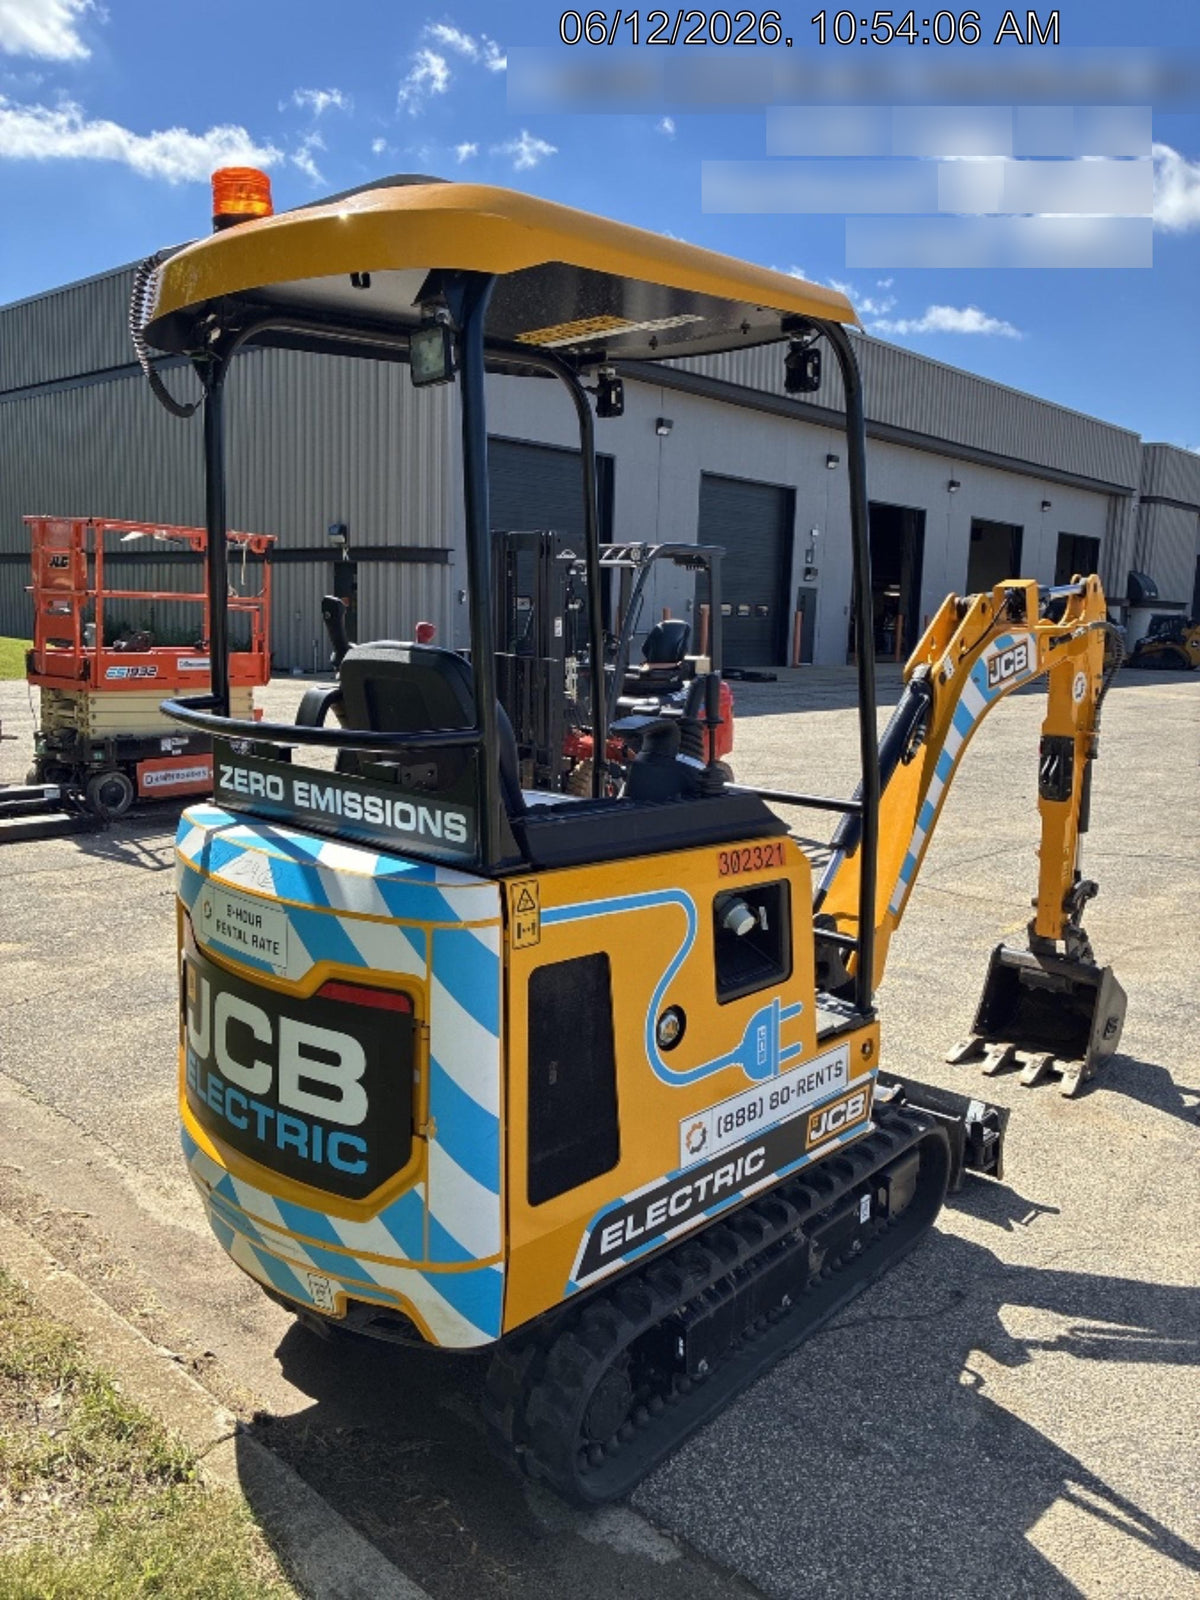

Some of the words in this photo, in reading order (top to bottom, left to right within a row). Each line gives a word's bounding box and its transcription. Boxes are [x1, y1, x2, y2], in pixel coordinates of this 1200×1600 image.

[990, 645, 1027, 684] JCB
[220, 764, 284, 802] ZERO
[293, 780, 467, 844] EMISSIONS
[719, 843, 784, 876] 302321
[252, 934, 279, 955] RATE
[187, 977, 369, 1127] JCB
[187, 1048, 368, 1175] ELECTRIC
[717, 1098, 764, 1138] (888)
[769, 1060, 844, 1110] 80-RENTS
[810, 1091, 865, 1141] JCB
[600, 1146, 766, 1255] ELECTRIC
